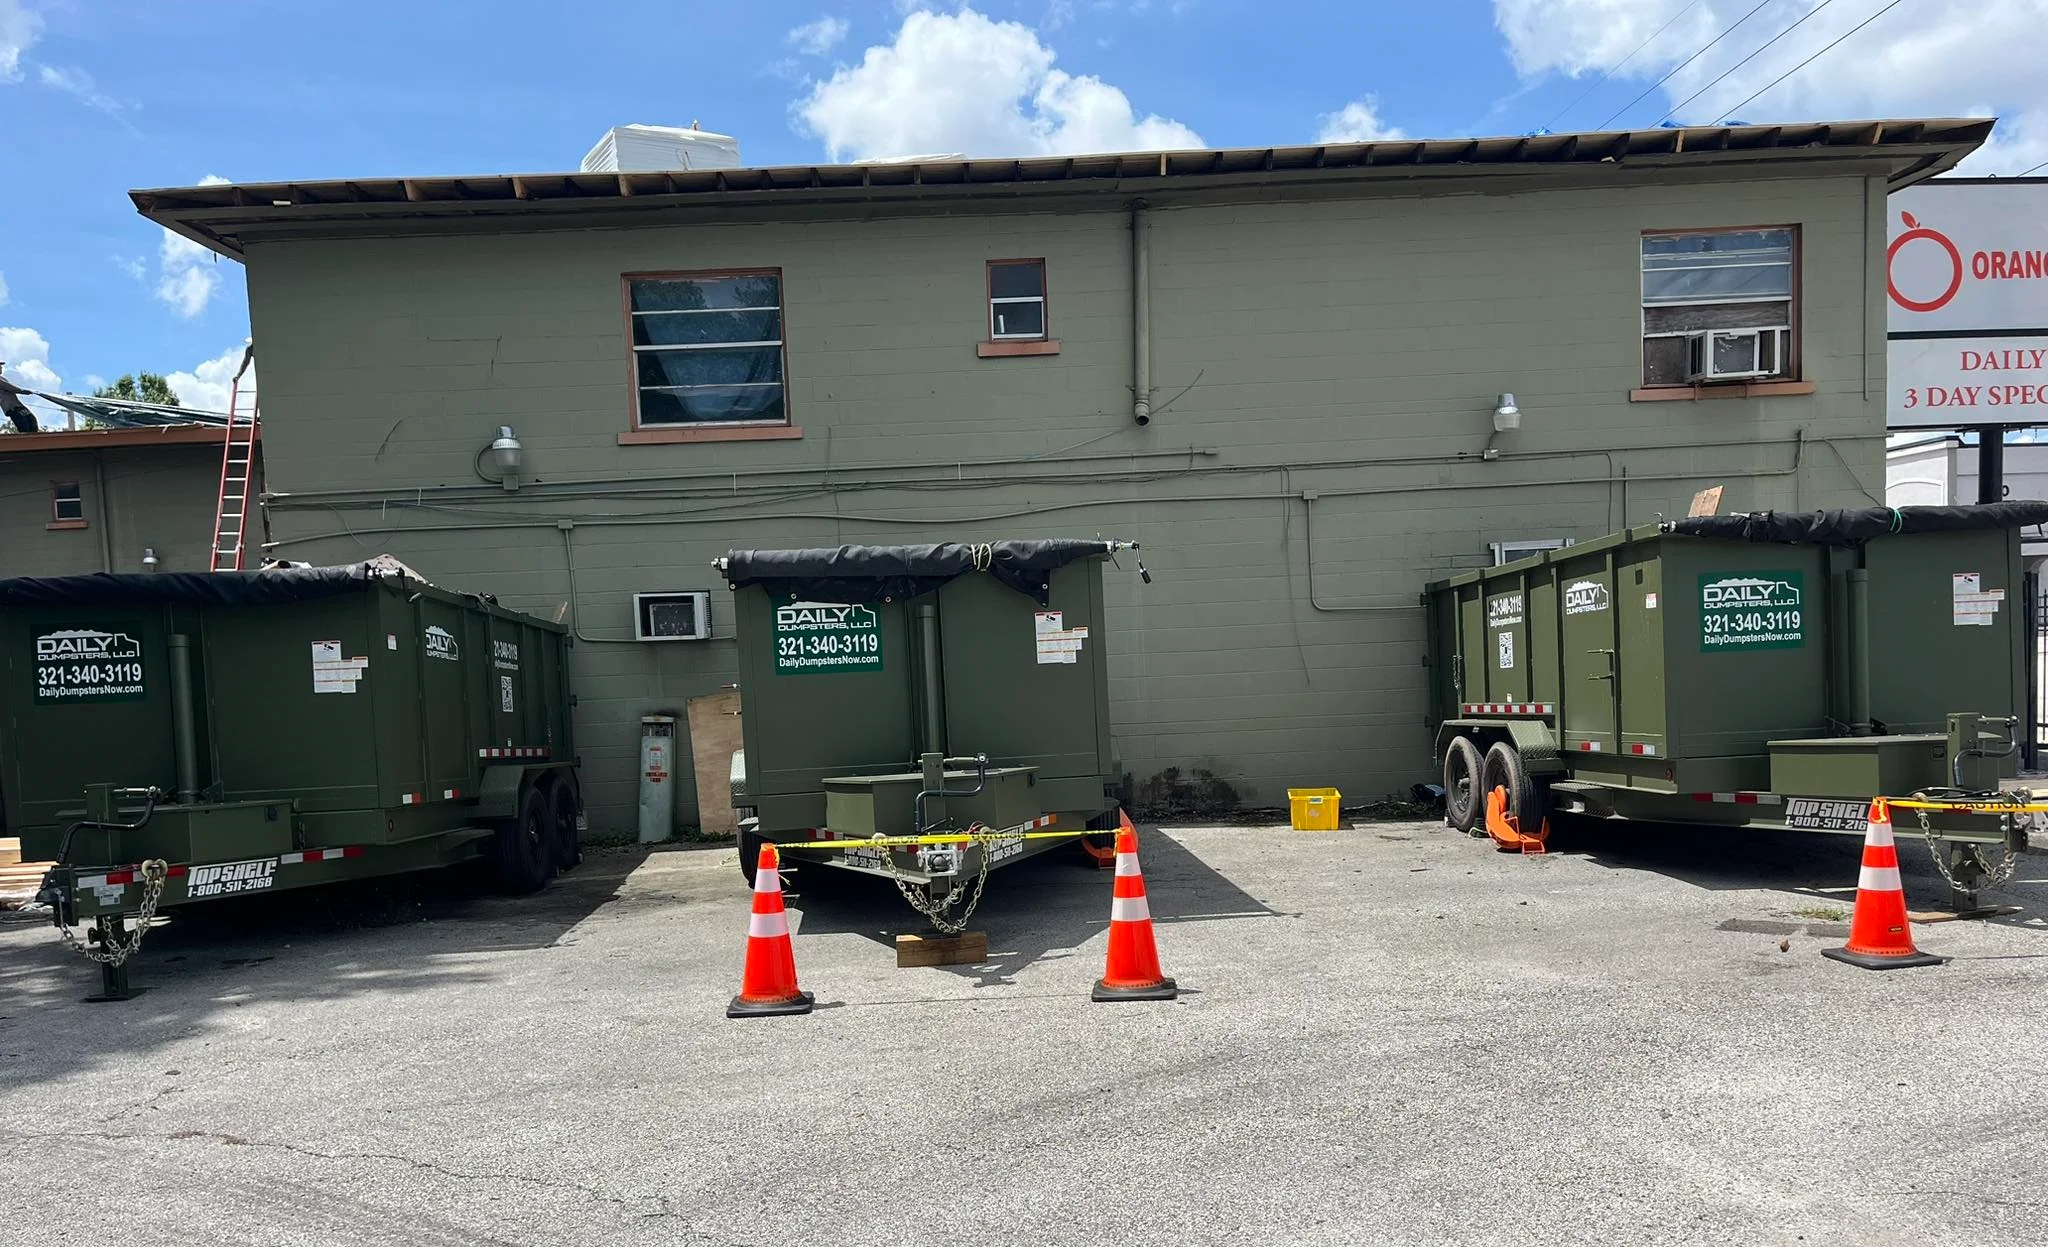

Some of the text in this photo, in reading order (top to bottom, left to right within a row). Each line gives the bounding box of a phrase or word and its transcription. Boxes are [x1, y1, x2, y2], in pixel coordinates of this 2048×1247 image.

[1960, 350, 2048, 371] DAILY
[1904, 388, 1918, 408] 3
[1926, 386, 1983, 407] DAY
[1566, 588, 1597, 608] DAILY
[1703, 585, 1775, 602] DAILY
[1703, 599, 1774, 609] DUMPSTERS,
[777, 608, 851, 624] DAILY
[1704, 611, 1801, 633] 321-340-3119
[778, 622, 849, 631] DUMPSTERS,
[37, 637, 113, 653] DAILY
[778, 634, 878, 656] 321-340-3119
[1704, 632, 1801, 646] DailyDumpstersNow.com
[37, 650, 136, 661] DUMPSTERS, LLC
[779, 655, 879, 669] DailyDumpstersNow.com
[38, 663, 142, 685] 321-340-3119
[39, 684, 143, 698] DailyDumpstersNow.com
[1785, 815, 1868, 830] 1-800-511-216
[187, 876, 273, 898] 1-800-511-2168
